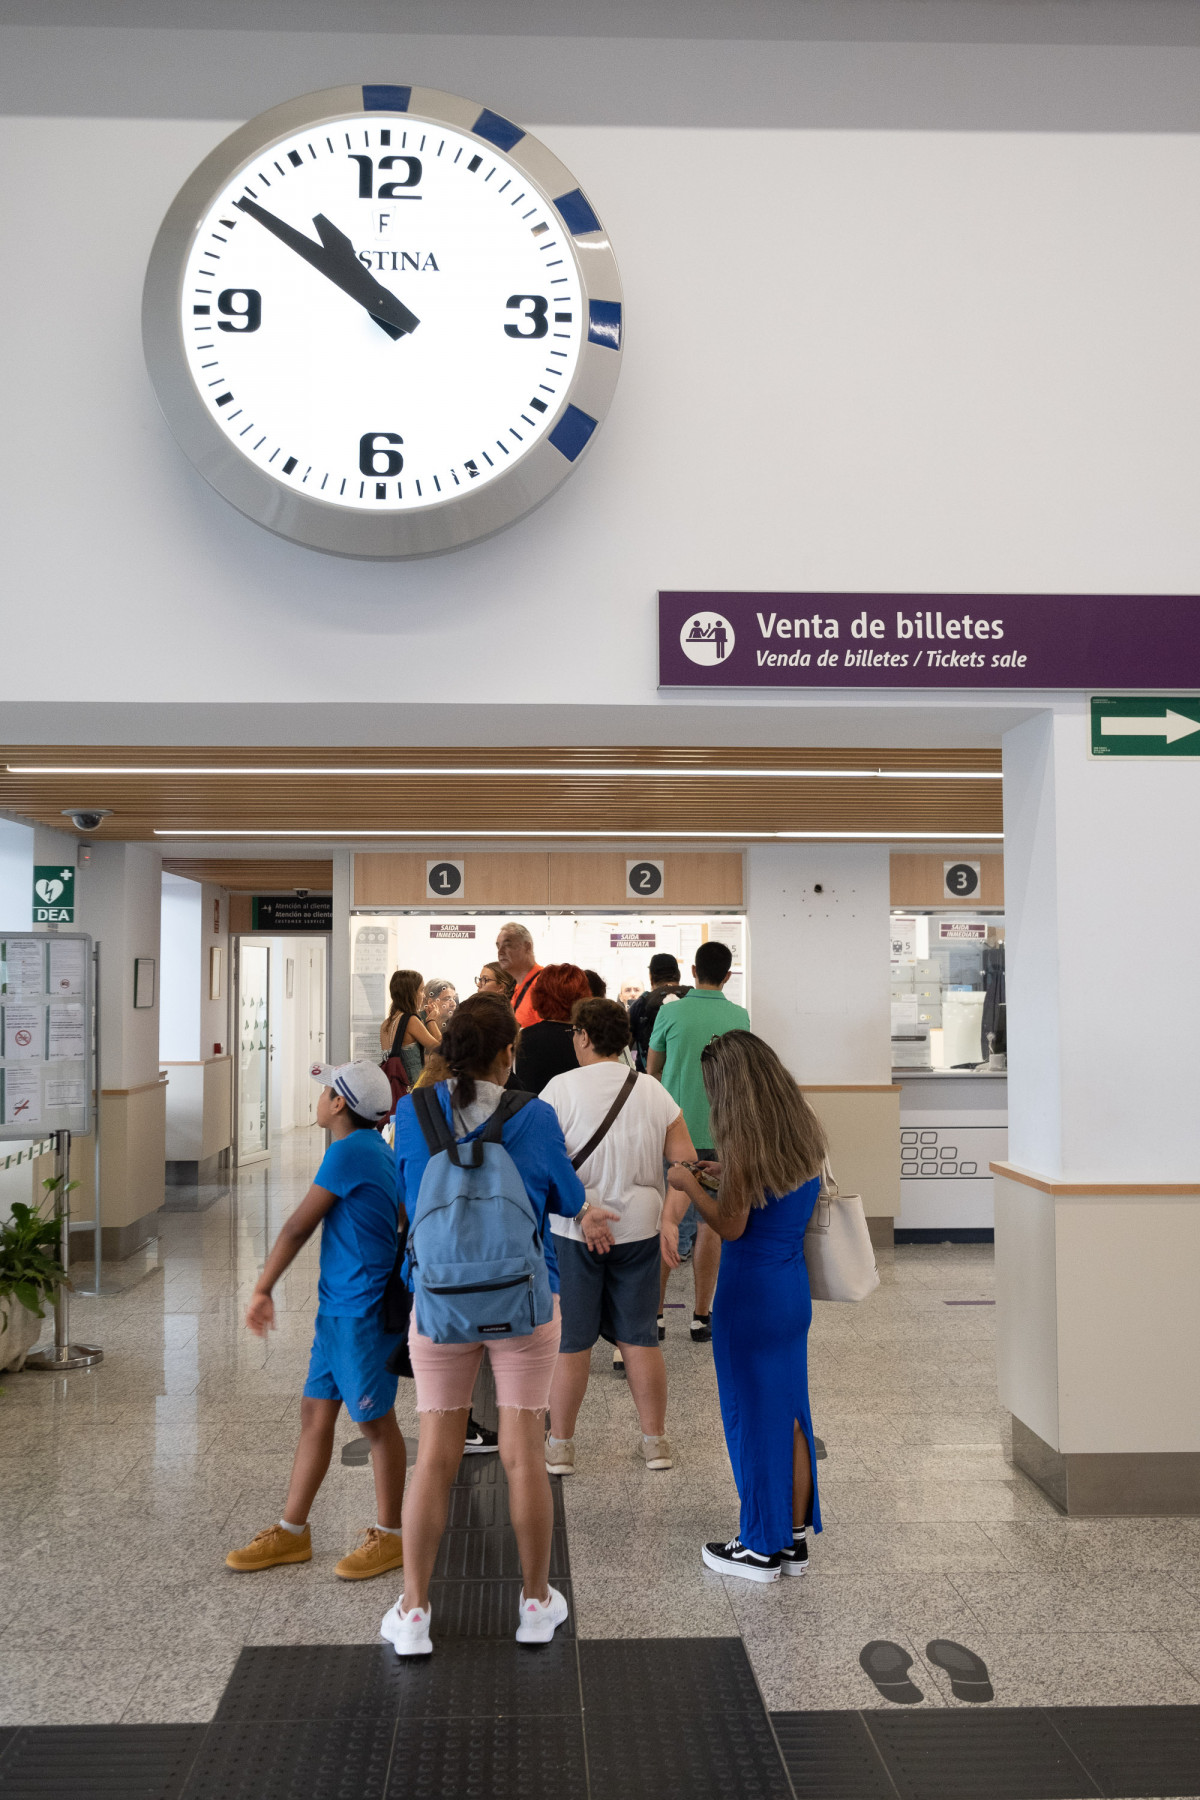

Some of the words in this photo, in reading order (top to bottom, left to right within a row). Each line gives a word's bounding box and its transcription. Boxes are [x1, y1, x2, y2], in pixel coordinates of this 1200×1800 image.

[347, 155, 422, 200] 12
[379, 213, 391, 233] F
[354, 250, 441, 272] STINA
[217, 288, 262, 333] 9
[503, 294, 549, 339] 3
[359, 432, 404, 477] 6
[756, 612, 840, 639] Venta
[850, 611, 886, 639] de
[896, 611, 1004, 640] billetes
[756, 649, 811, 667] Venda
[816, 649, 839, 667] de
[843, 649, 910, 667] billetes
[912, 650, 923, 667] /
[926, 649, 986, 668] Tickets
[990, 650, 1028, 668] sale
[440, 870, 450, 888] 1
[639, 870, 651, 888] 2
[956, 871, 968, 889] 3
[37, 909, 70, 921] DEA
[275, 910, 302, 918] Atención
